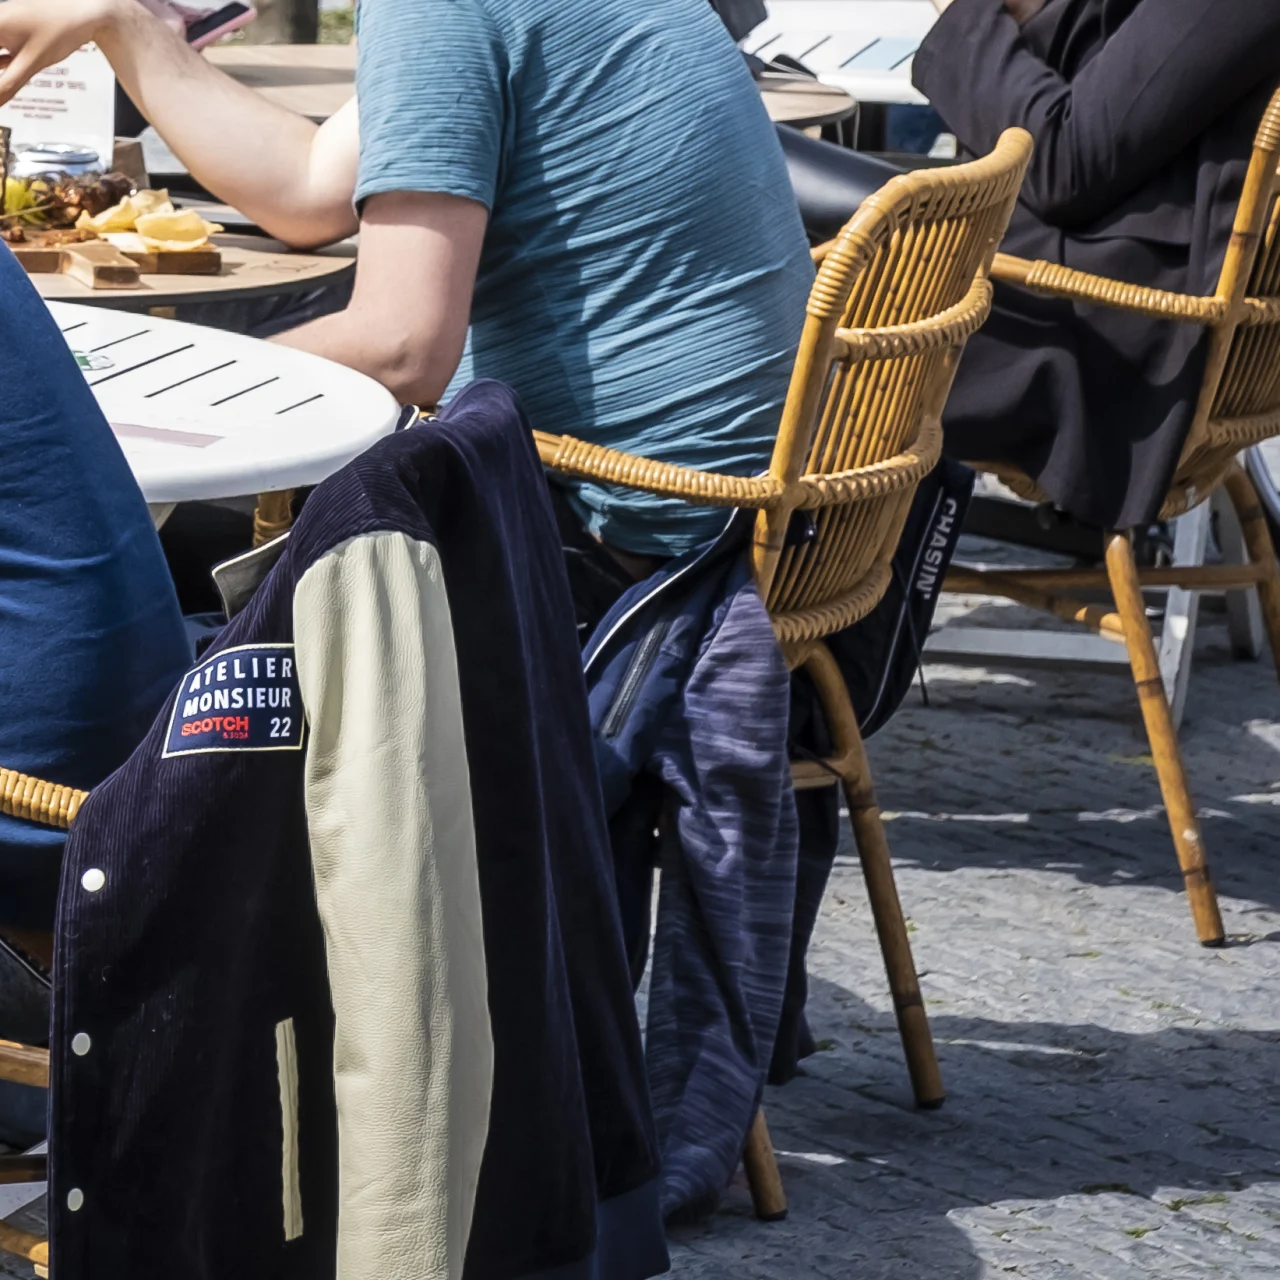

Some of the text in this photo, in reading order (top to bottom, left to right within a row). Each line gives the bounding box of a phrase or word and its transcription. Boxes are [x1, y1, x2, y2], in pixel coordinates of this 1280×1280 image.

[915, 497, 957, 600] CHASIN'
[188, 657, 293, 694] ATELIER
[182, 687, 292, 718] MONSIEUR
[181, 716, 250, 737] SCOTCH
[269, 717, 292, 738] 22
